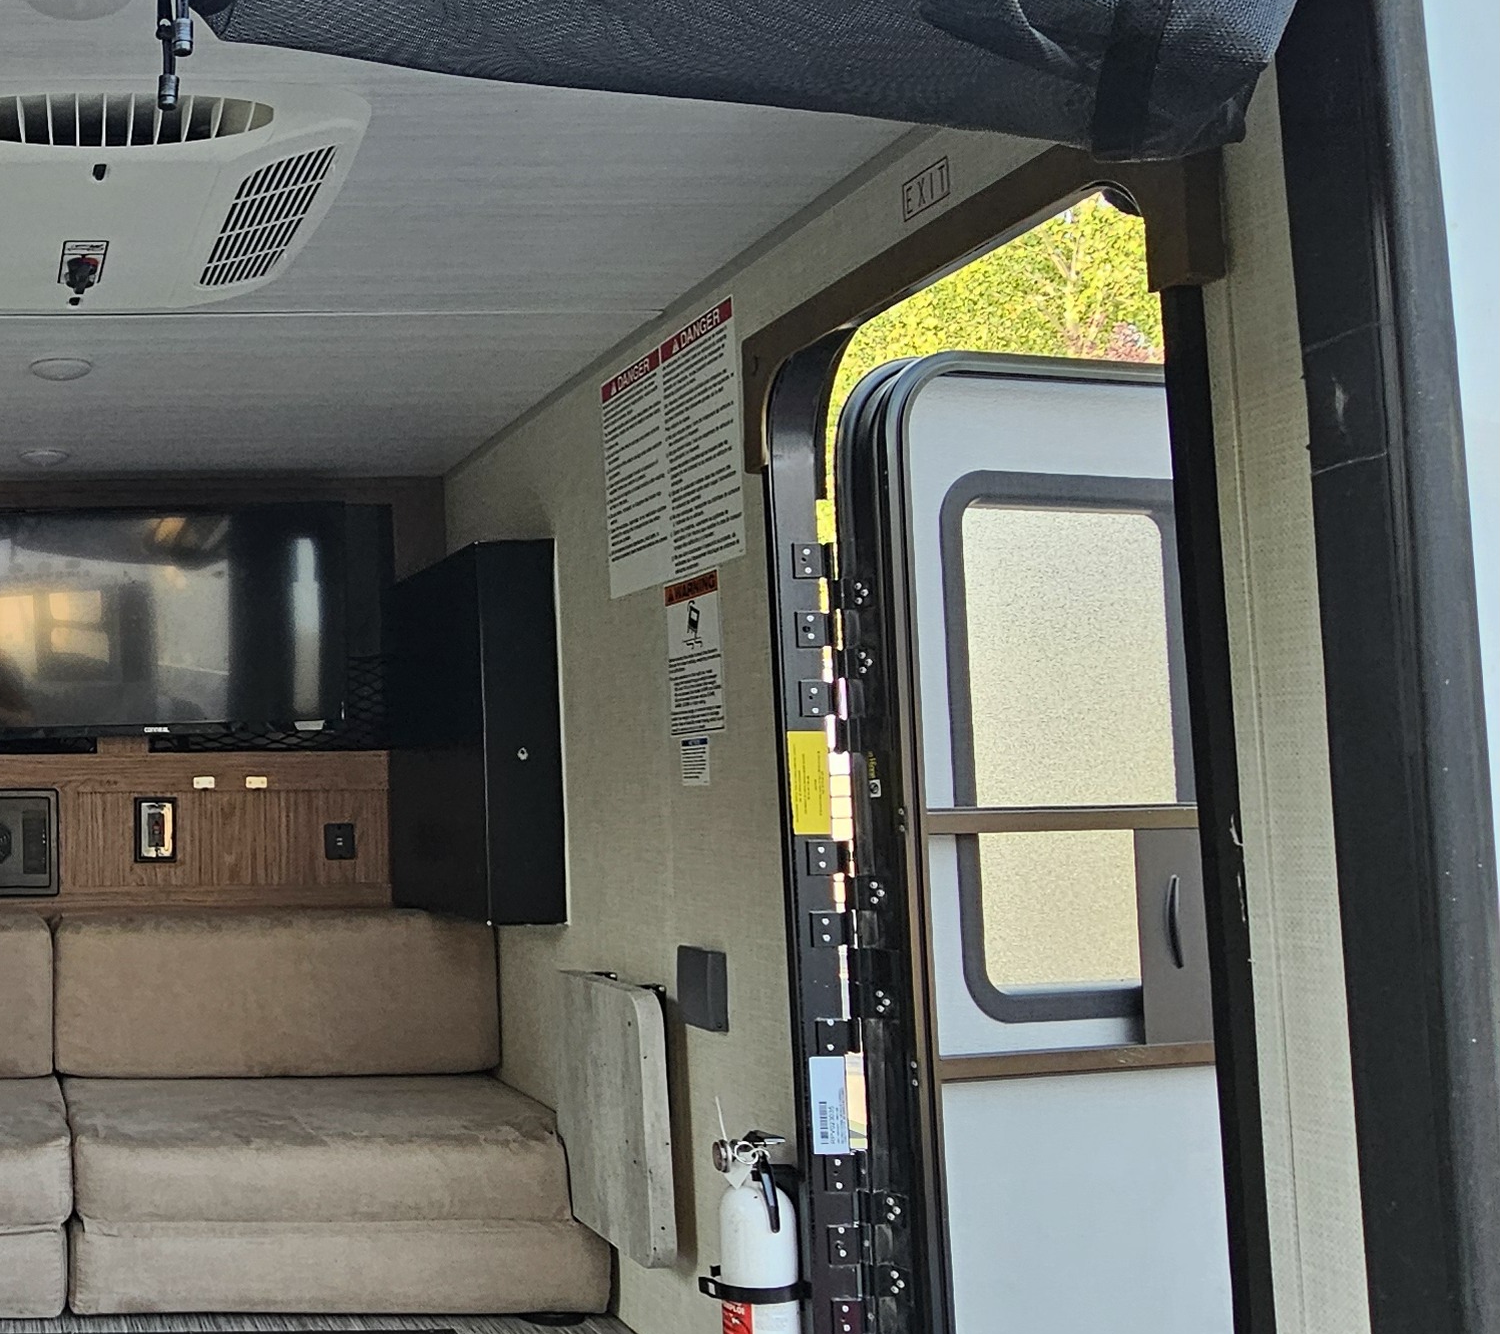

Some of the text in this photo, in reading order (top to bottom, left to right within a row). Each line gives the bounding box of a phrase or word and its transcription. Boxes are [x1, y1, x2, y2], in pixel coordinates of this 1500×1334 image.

[906, 164, 945, 214] EXIT
[680, 308, 720, 348] DANGER
[617, 358, 650, 390] DANGER
[675, 574, 716, 601] WARNING
